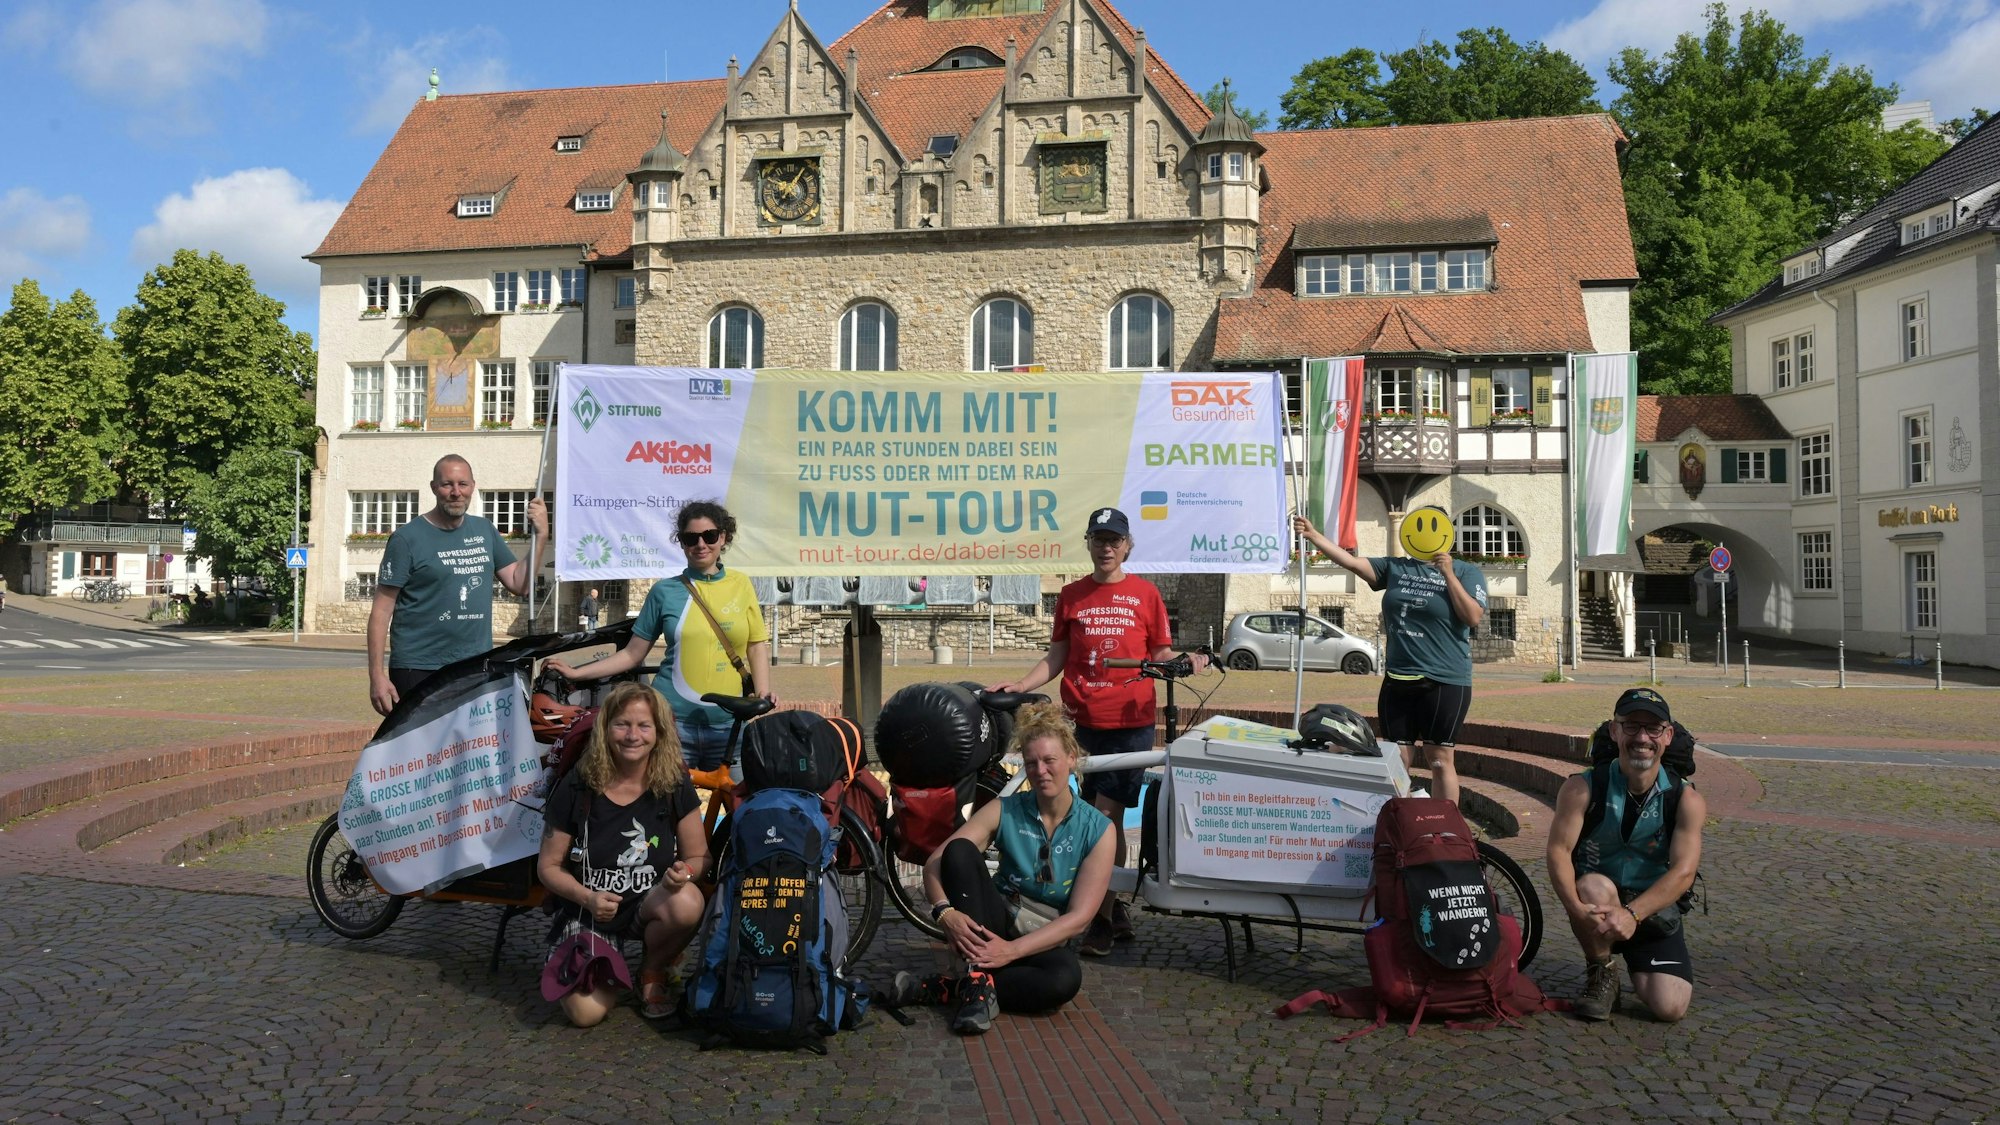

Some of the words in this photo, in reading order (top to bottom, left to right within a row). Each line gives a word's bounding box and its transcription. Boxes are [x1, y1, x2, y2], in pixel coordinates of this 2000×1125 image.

[691, 380, 715, 393] LVR
[1171, 382, 1253, 406] DAK
[608, 404, 662, 417] STIFTUNG
[797, 390, 942, 433] KOMM
[962, 391, 1058, 433] MIT!
[1172, 407, 1256, 421] Gesundheit
[798, 441, 825, 457] EIN
[831, 441, 876, 457] PAAR
[881, 441, 960, 457] STUNDEN
[966, 442, 1014, 457] DABEI
[1020, 442, 1058, 457] SEIN
[1145, 443, 1277, 467] BARMER
[662, 465, 712, 474] MENSCH
[798, 464, 822, 481] ZU
[829, 464, 876, 481] FUSS
[883, 464, 930, 481] ODER
[937, 464, 970, 481] MIT
[977, 464, 1016, 481] DEM
[1023, 463, 1060, 480] RAD
[1176, 499, 1243, 507] Rentenversicherung
[798, 489, 1061, 537] MUT-TOUR
[620, 533, 647, 542] Anni
[1190, 534, 1228, 551] Mut
[437, 547, 487, 558] DEPRESSIONEN.
[620, 546, 659, 555] Gruber
[799, 538, 1062, 563] mut-tour.de/dabei-sein
[457, 555, 490, 566] SPRECHEN
[620, 559, 665, 569] Stiftung
[1190, 555, 1220, 563] fördern
[453, 565, 485, 575] DARÜBER!
[1077, 606, 1136, 618] DEPRESSIONEN.
[1079, 617, 1091, 625] WIR
[1094, 617, 1135, 627] SPRECHEN
[1085, 626, 1124, 635] DARÜBER!
[469, 701, 492, 719] Mut
[368, 768, 386, 783] Ich
[389, 763, 404, 778] bin
[407, 758, 424, 772] ein
[426, 734, 500, 767] Begleitfahrzeug
[370, 781, 411, 803] GROSSE
[414, 754, 491, 792] MUT-WANDERUNG
[1175, 769, 1193, 778] Mut
[344, 810, 382, 830] Schließe
[385, 802, 407, 819] dich
[409, 790, 452, 812] unserem
[520, 758, 538, 773] ein
[1202, 792, 1215, 801] Ich
[1218, 793, 1231, 801] bin
[1233, 793, 1246, 802] ein
[1248, 793, 1316, 807] Begleitfahrzeug
[1202, 805, 1233, 816] GROSSE
[1236, 807, 1308, 819] MUT-WANDERUNG
[1310, 811, 1331, 820] 2025
[355, 835, 374, 851] paar
[375, 823, 415, 843] Stunden
[417, 815, 435, 832] an!
[436, 810, 451, 826] Für
[473, 796, 494, 813] Mut
[1194, 818, 1229, 829] Schließe
[1231, 819, 1249, 829] dich
[1251, 821, 1287, 831] unserem
[1290, 822, 1343, 833] Wanderteam
[1346, 824, 1358, 834] für
[1361, 826, 1374, 835] ein
[366, 855, 377, 867] im
[377, 844, 419, 864] Umgang
[420, 837, 437, 853] mit
[437, 824, 482, 849] Depression
[484, 818, 491, 833] &
[493, 815, 507, 830] Co.
[1197, 835, 1216, 843] paar
[1218, 833, 1252, 844] Stunden
[1254, 835, 1267, 845] an!
[1269, 835, 1283, 845] Für
[1286, 837, 1307, 846] mehr
[1310, 838, 1325, 847] Mut
[1328, 839, 1344, 848] und
[1203, 847, 1213, 856] im
[1216, 847, 1249, 859] Umgang
[1251, 848, 1265, 858] mit
[1267, 849, 1314, 862] Depression
[1316, 852, 1322, 861] &
[1325, 852, 1339, 862] Co.
[778, 889, 793, 897] DEM
[1428, 886, 1460, 899] WENN
[1461, 885, 1486, 895] NICHT
[1447, 896, 1477, 909] JETZT?
[1438, 907, 1488, 922] WANDERN?
[741, 915, 757, 935] Mut
